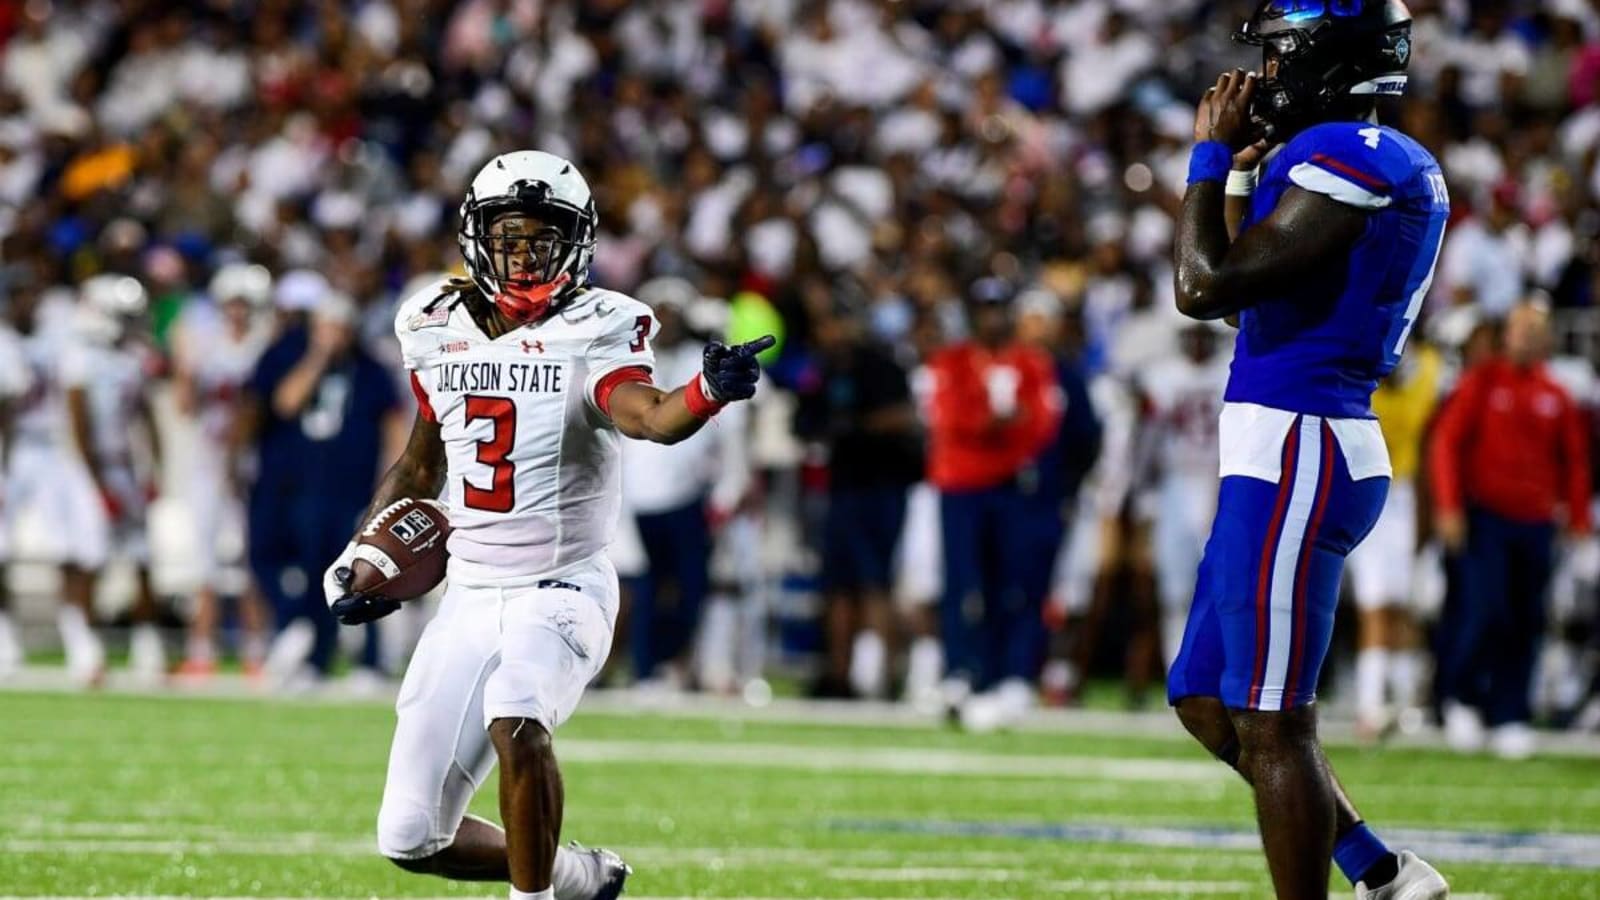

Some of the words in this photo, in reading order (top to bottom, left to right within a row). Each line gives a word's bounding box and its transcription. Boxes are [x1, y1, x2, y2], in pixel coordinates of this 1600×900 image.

[629, 315, 652, 353] 3
[437, 362, 502, 392] JACKSON
[507, 363, 563, 392] STATE
[463, 394, 517, 513] 3
